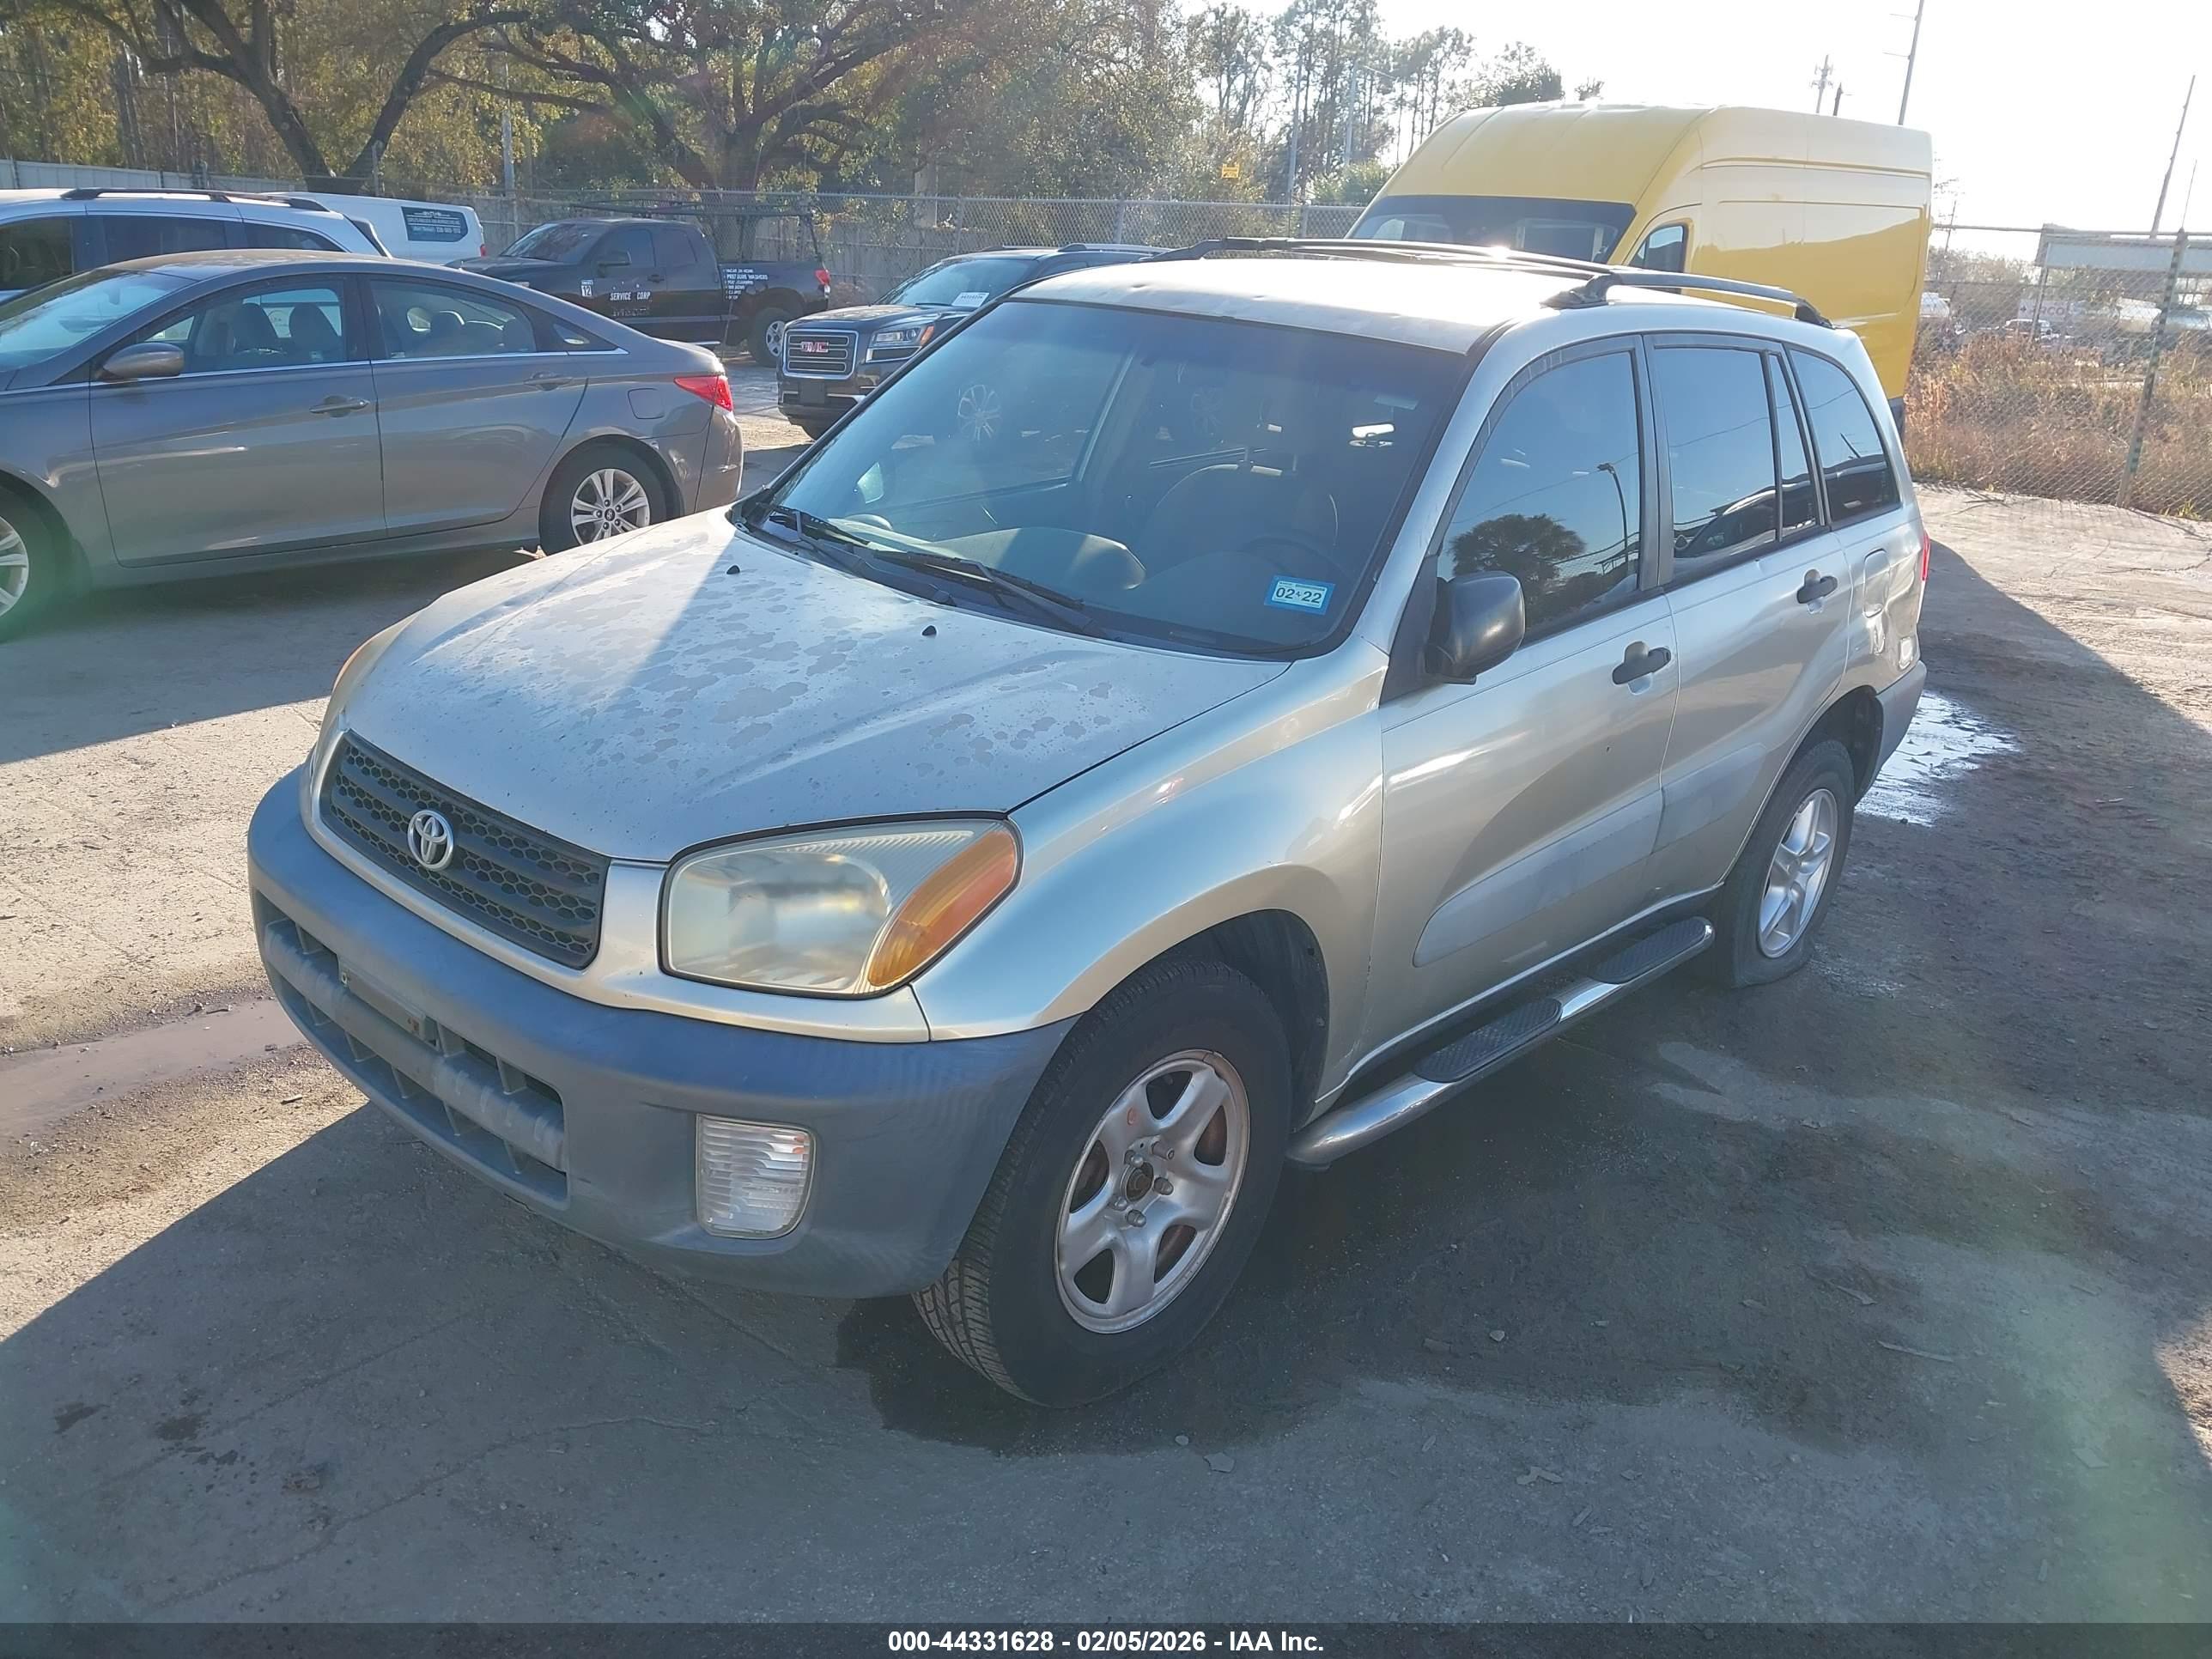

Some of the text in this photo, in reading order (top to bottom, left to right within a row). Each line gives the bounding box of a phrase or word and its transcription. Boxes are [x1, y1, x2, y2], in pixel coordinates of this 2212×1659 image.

[610, 291, 651, 301] SERVICE CORP
[801, 341, 830, 353] GMC
[1276, 587, 1322, 604] 02 22
